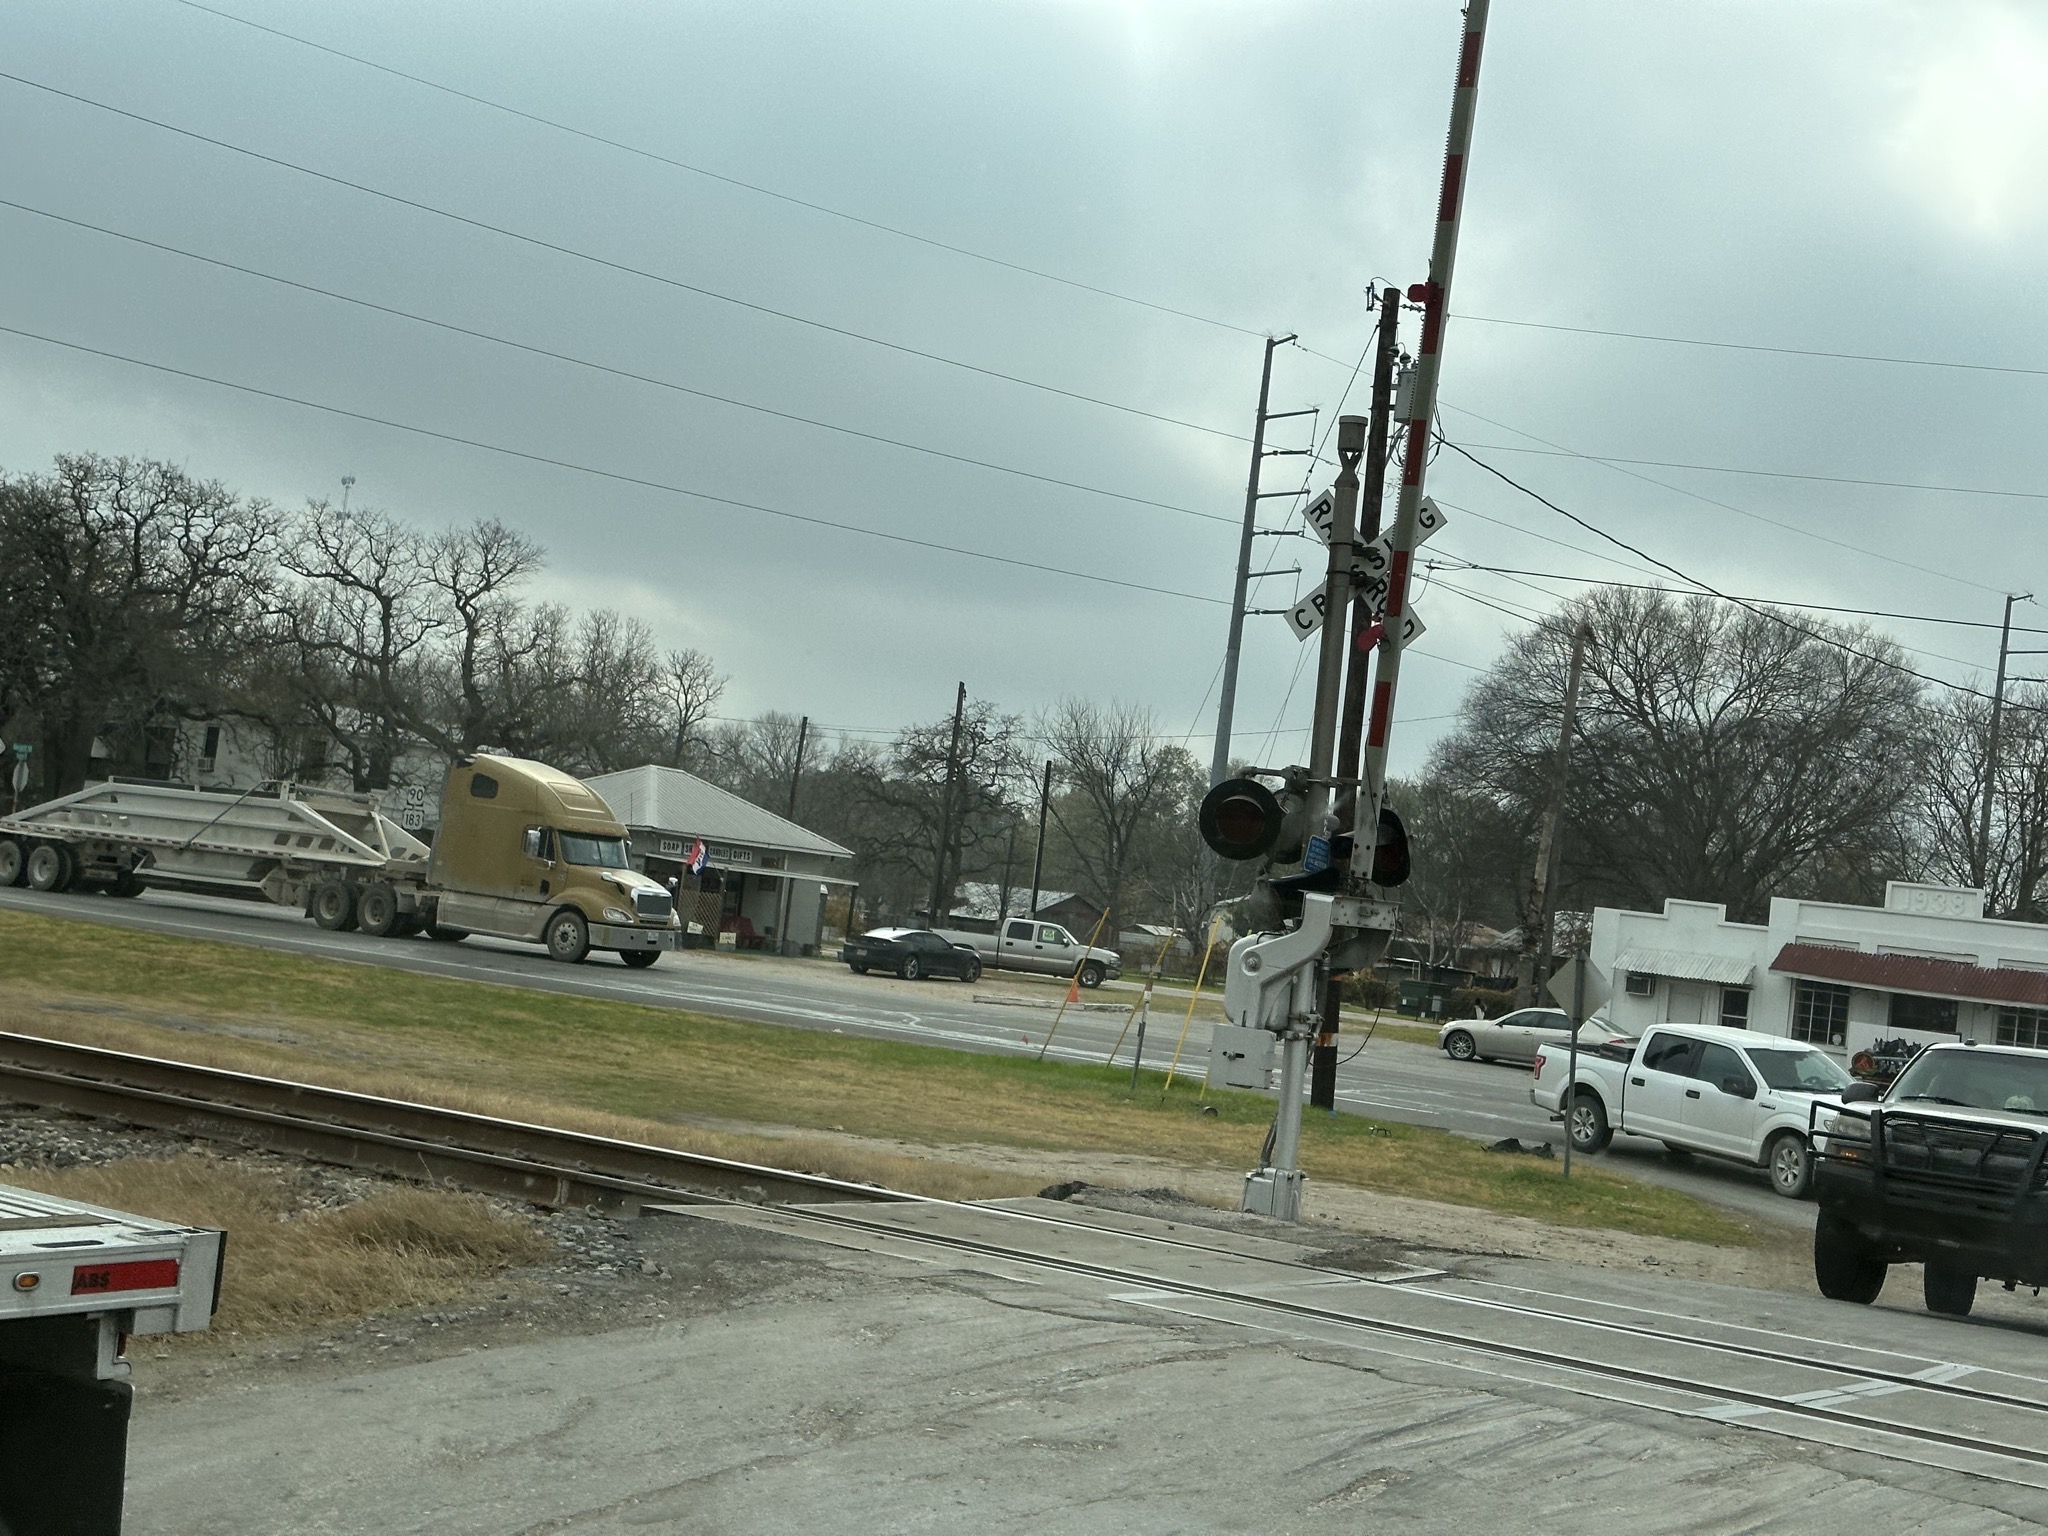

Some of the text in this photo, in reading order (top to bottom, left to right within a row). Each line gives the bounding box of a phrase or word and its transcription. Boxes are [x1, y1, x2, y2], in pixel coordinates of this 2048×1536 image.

[1295, 508, 1435, 629] CRSSIG
[409, 788, 423, 801] 90
[405, 813, 420, 826] 183
[663, 841, 680, 852] SOAP
[733, 851, 751, 861] GIFTS
[1903, 889, 1964, 914] 1938
[74, 1271, 110, 1288] ABS
